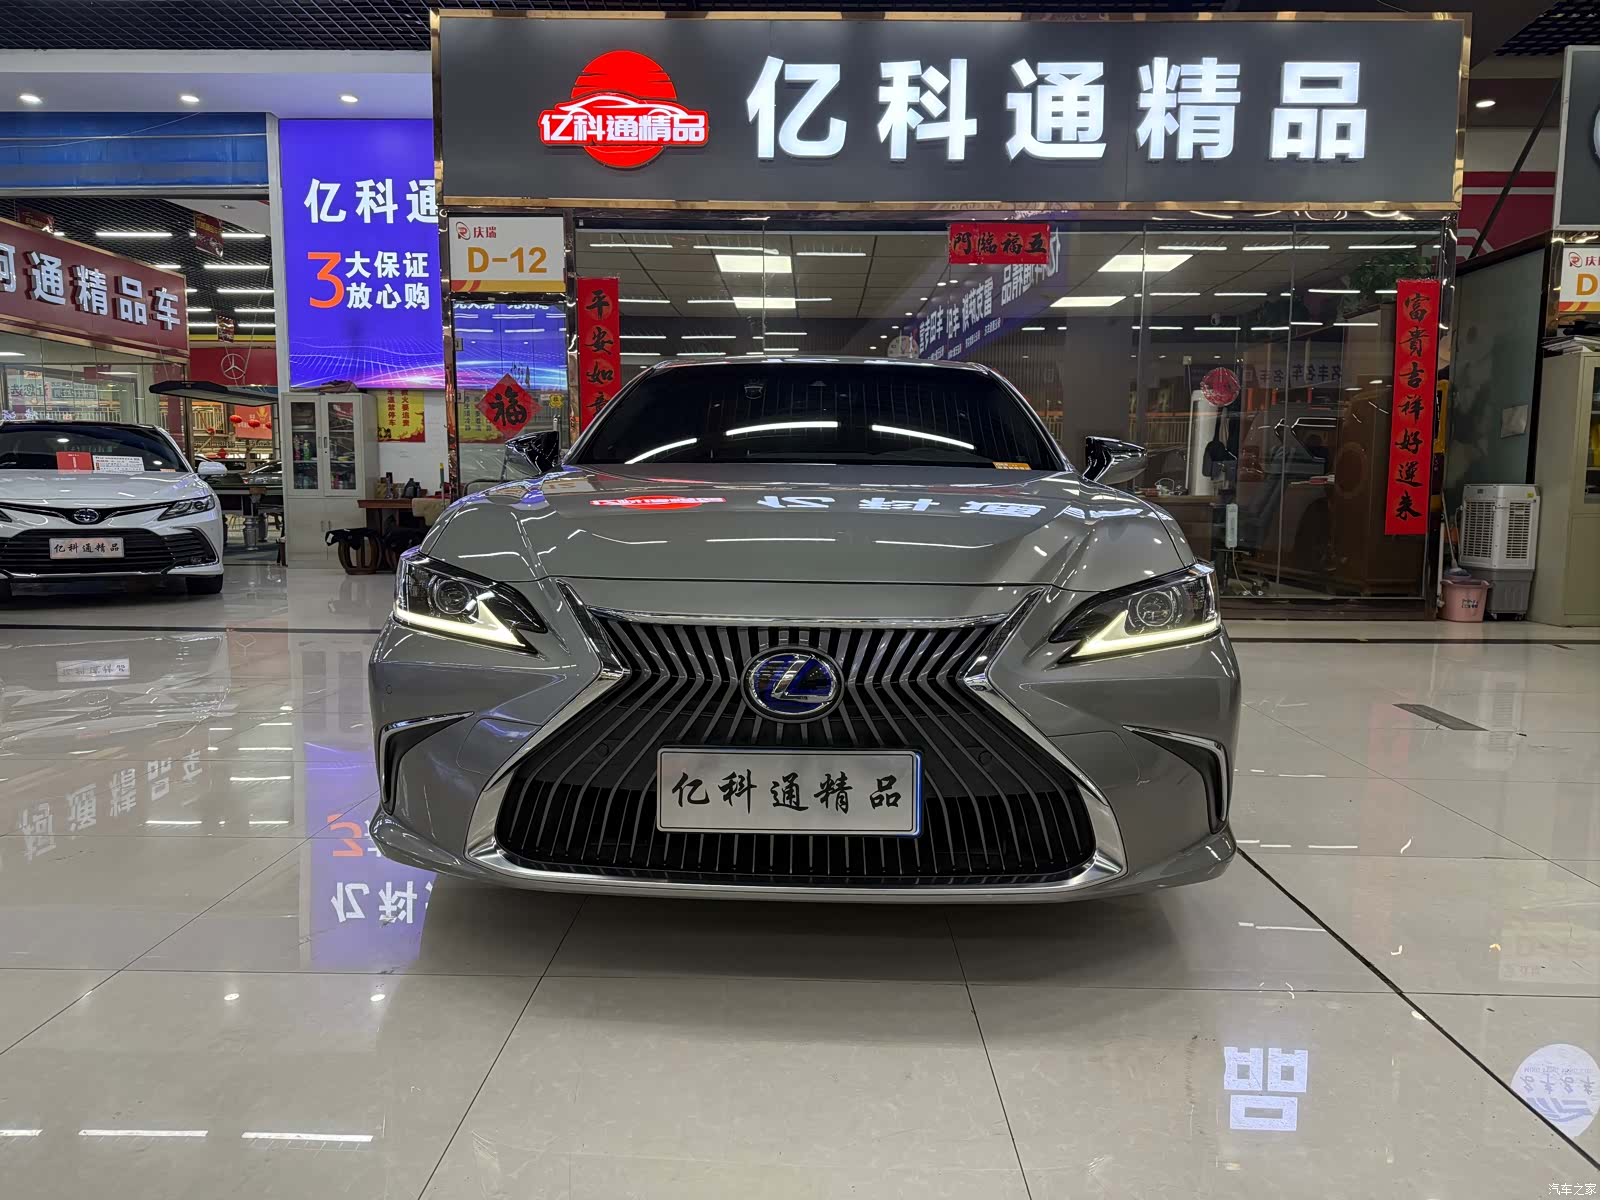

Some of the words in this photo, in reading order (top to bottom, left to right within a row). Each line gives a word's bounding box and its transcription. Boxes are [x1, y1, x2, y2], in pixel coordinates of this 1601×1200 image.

[747, 55, 1367, 161] 亿科通精品
[541, 114, 705, 142] 亿科通精品
[473, 226, 497, 239] 庆瑞
[467, 246, 547, 273] D-12
[307, 252, 344, 308] 3
[345, 251, 430, 278] 大保证
[347, 283, 430, 309] 放心购
[488, 385, 527, 427] 福
[53, 543, 120, 553] 亿科通精品
[672, 769, 902, 814] 亿科通精品
